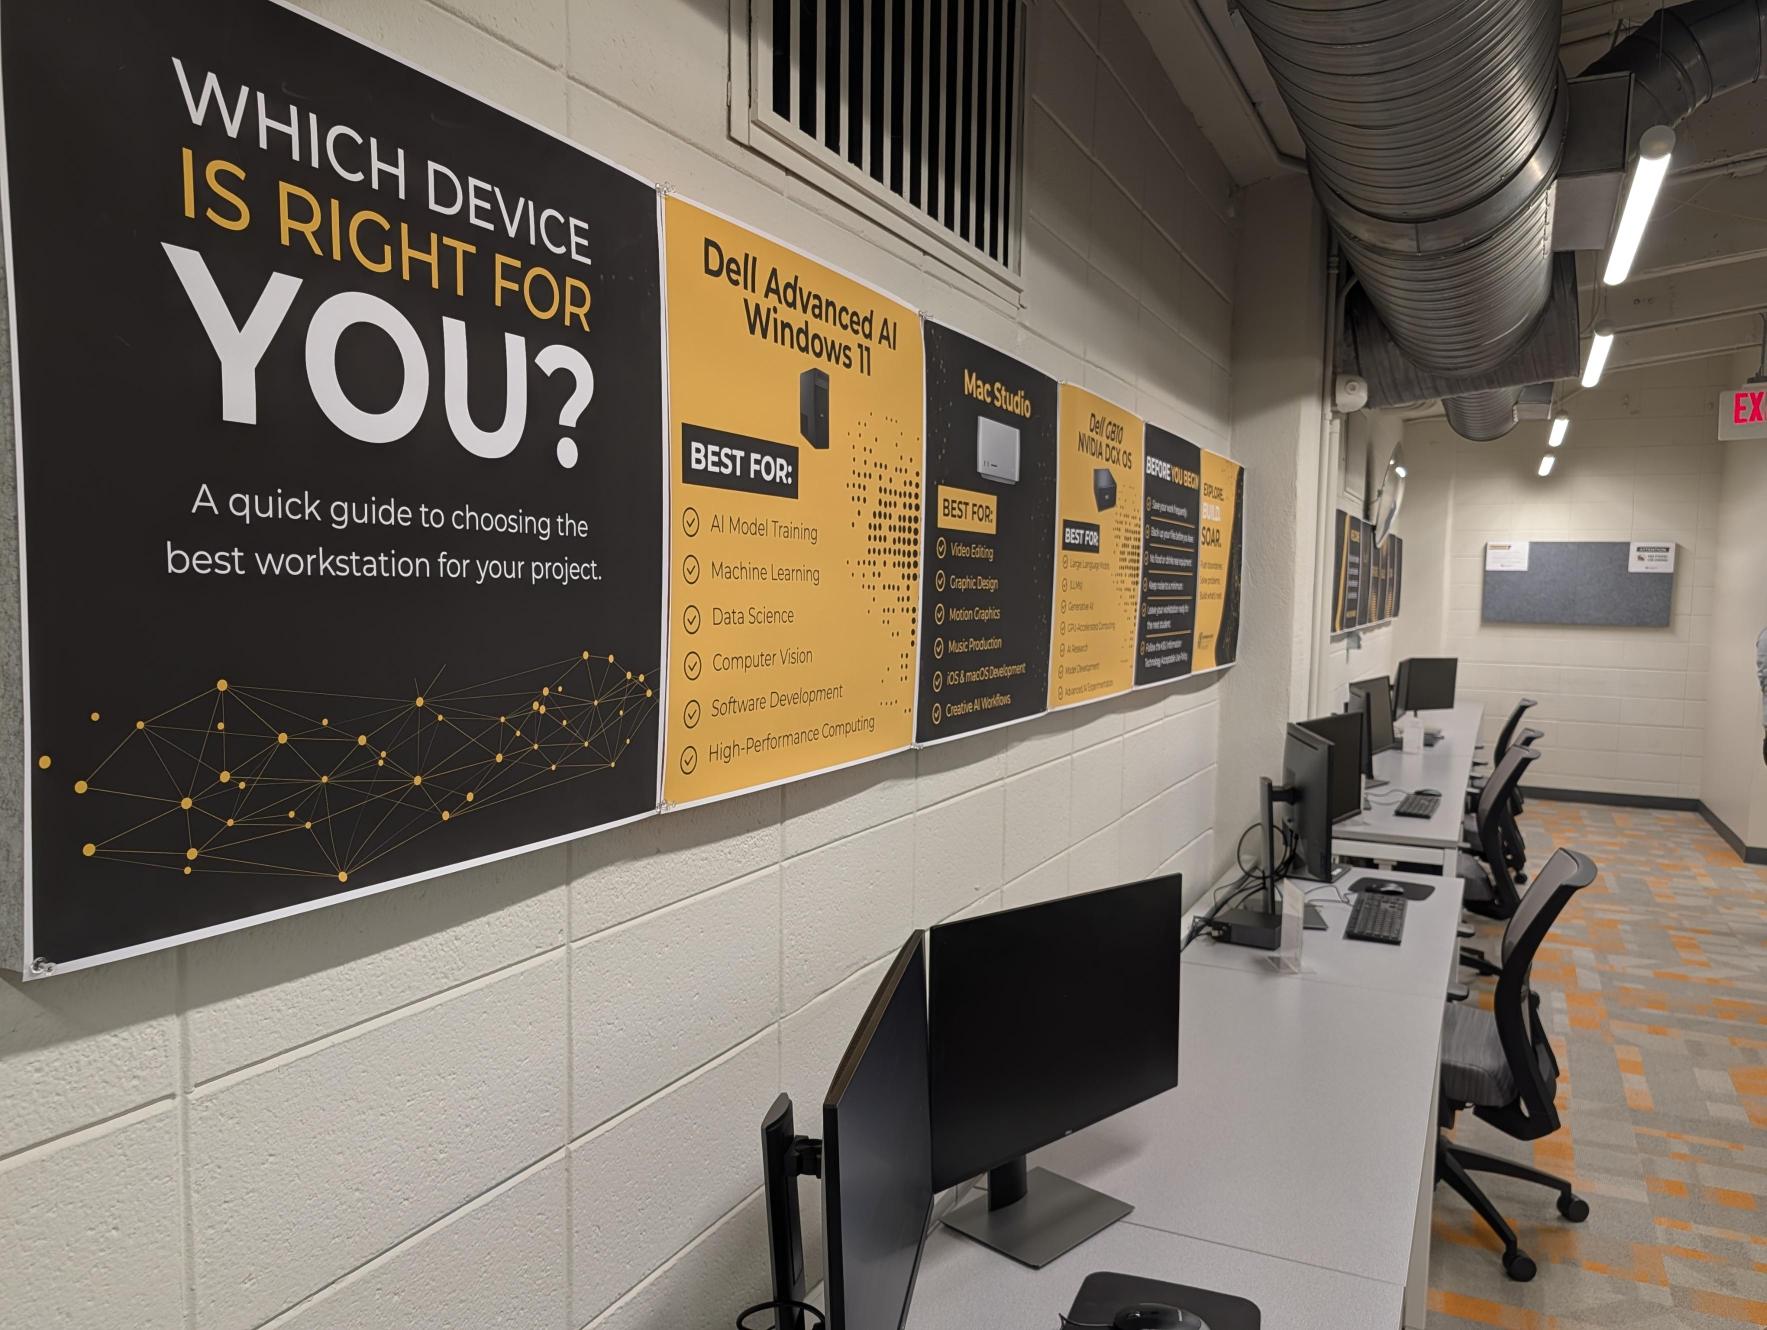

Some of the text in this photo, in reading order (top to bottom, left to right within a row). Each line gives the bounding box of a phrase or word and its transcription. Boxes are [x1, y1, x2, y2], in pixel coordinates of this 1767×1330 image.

[171, 56, 592, 265] WHICH DEVICE
[182, 147, 591, 332] IS RIGHT FOR
[704, 236, 897, 350] Dell Advanced AI
[743, 298, 871, 376] Windows 11
[161, 242, 594, 469] YOU?
[964, 368, 1031, 418] Mac Studio
[1734, 391, 1767, 424] EX
[1090, 413, 1105, 436] Dell
[691, 441, 793, 484] BEST FOR:
[1078, 432, 1132, 470] NVIDIA DGX OS
[1146, 455, 1200, 490] BEFORE YOU BEGIN
[191, 483, 589, 540] A quick guide to choosing the
[943, 498, 993, 523] BEST FOR:
[711, 514, 818, 544] AI Model Training
[1065, 528, 1084, 544] BEST
[1201, 526, 1222, 548] SOAR.
[166, 541, 602, 585] best workstation for your project.
[951, 542, 994, 561] Video Editing
[711, 561, 820, 585] Machine Learning
[950, 576, 998, 592] Graphic Design
[712, 607, 794, 625] Data Science
[949, 607, 1000, 623] Motion Graphics
[712, 648, 813, 673] Computer Vision
[948, 637, 1002, 653] Music Production
[947, 663, 1026, 685] iOS & macOS Development
[711, 684, 843, 717] Software Development
[946, 693, 1011, 717] Creative AI Workflows
[709, 715, 875, 763] High-Performance Computing
